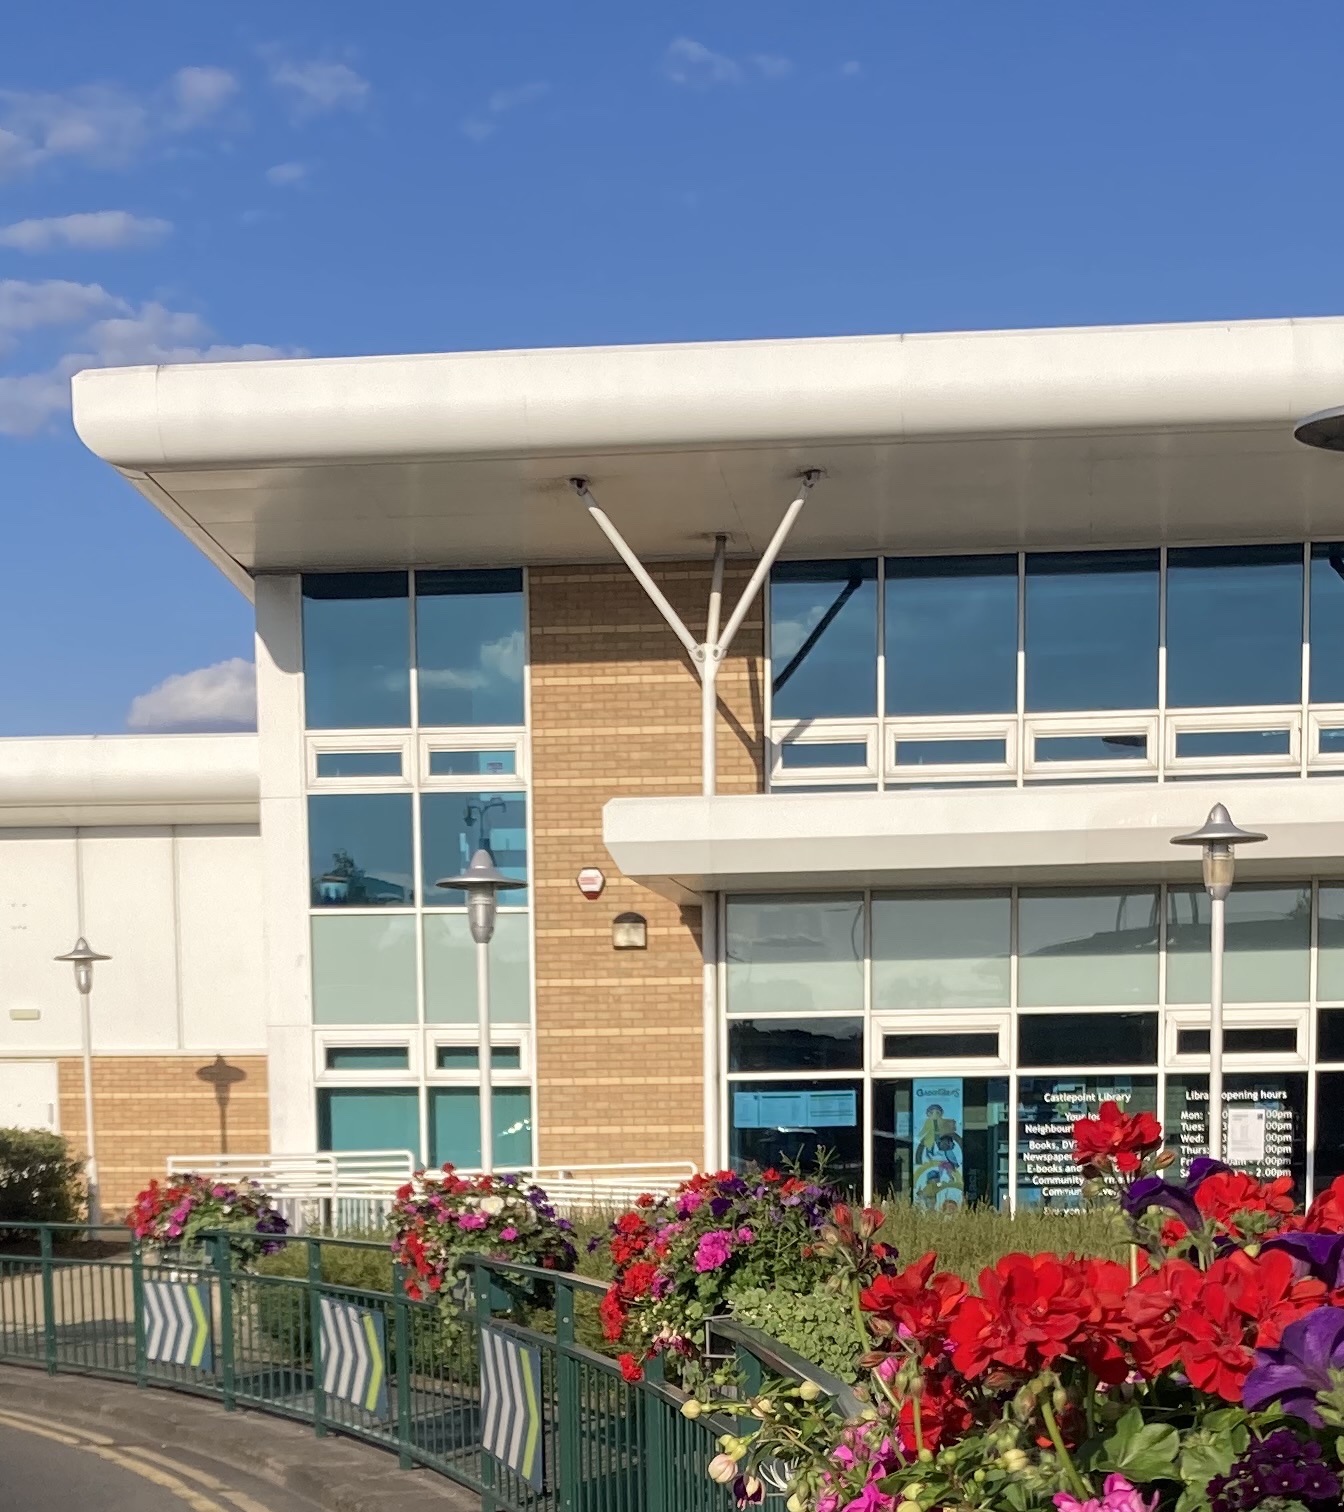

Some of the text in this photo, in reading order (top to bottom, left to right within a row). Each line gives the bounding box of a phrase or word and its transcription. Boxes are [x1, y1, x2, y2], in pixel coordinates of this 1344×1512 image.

[1044, 1092, 1132, 1103] Castlepoint Library
[1221, 1089, 1258, 1101] opening
[1260, 1089, 1288, 1099] hours
[1180, 1110, 1204, 1120] Mon:
[1181, 1122, 1205, 1131] Tues:
[1180, 1133, 1205, 1143] Wed:
[1029, 1140, 1060, 1150] Books,
[1032, 1175, 1084, 1186] Community
